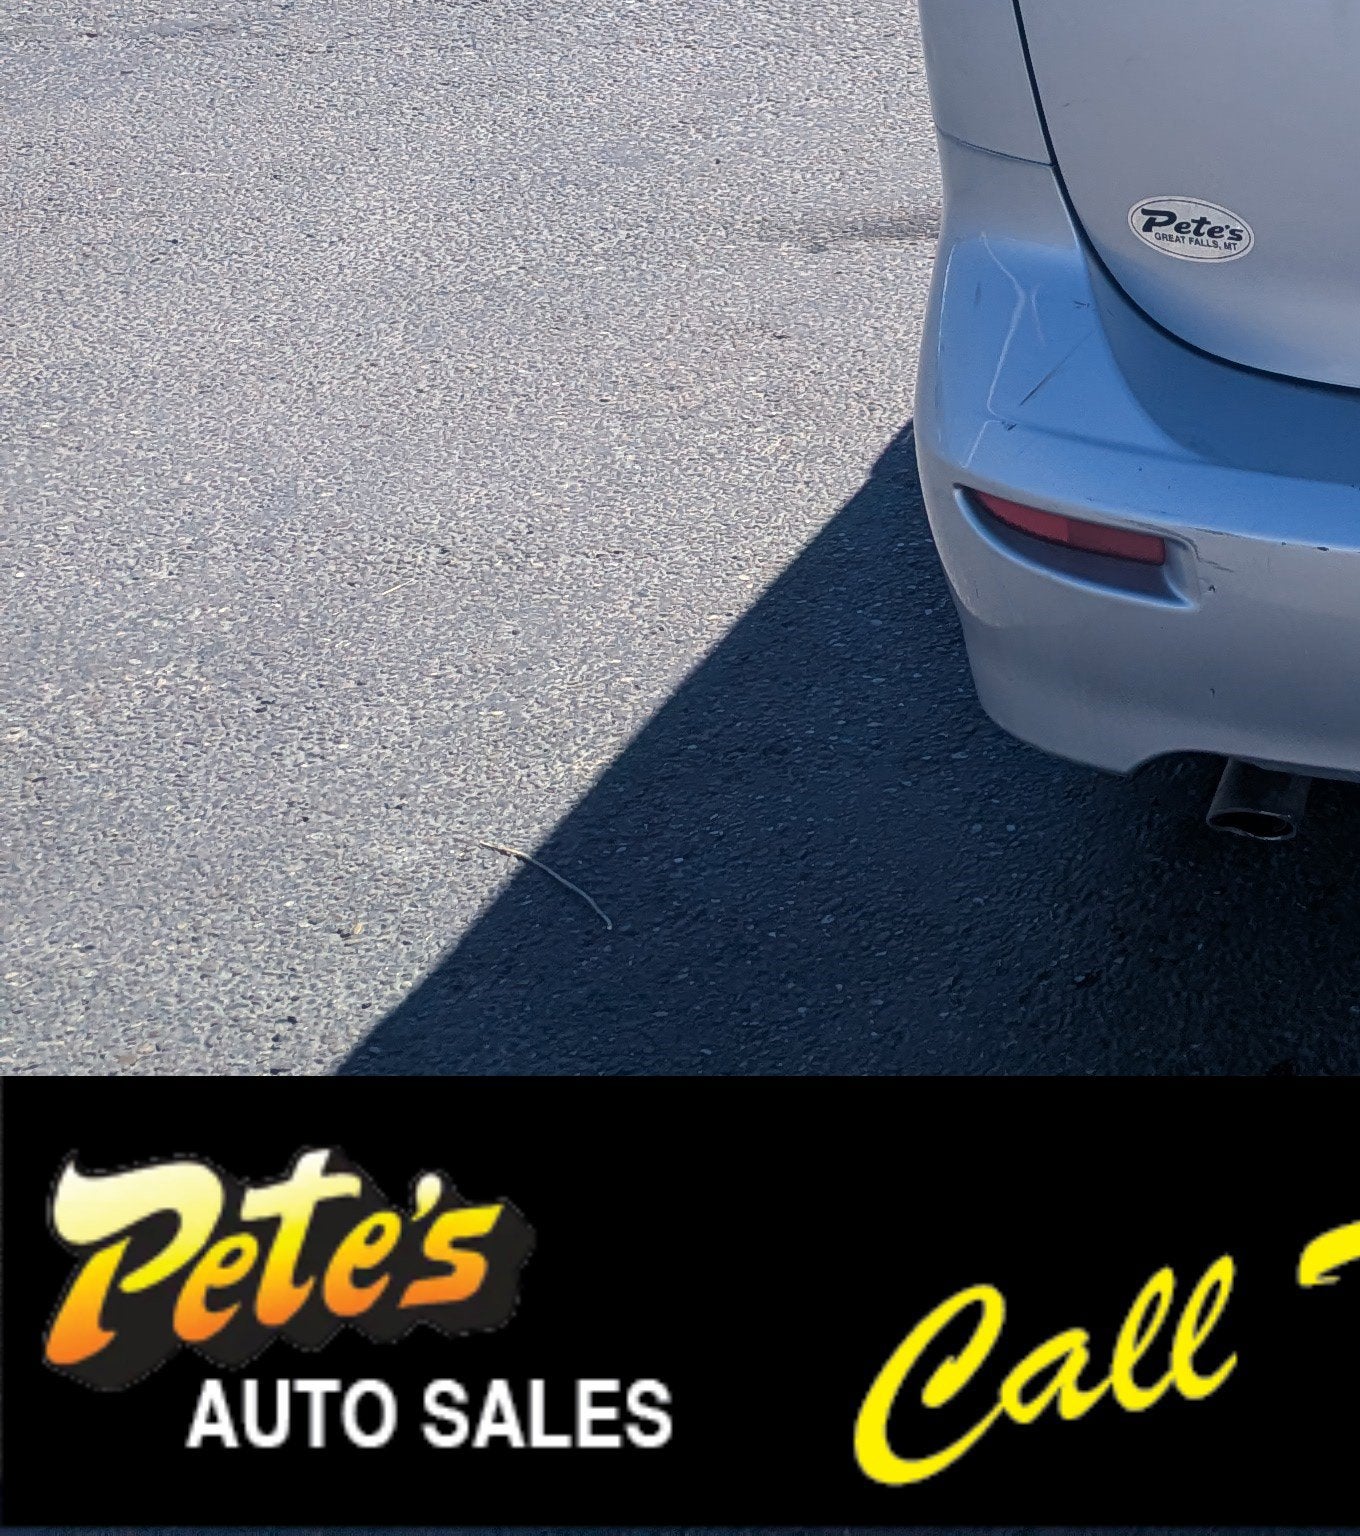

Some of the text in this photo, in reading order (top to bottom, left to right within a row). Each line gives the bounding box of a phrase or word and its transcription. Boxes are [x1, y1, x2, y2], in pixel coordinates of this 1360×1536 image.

[1141, 208, 1244, 241] Pete's
[1154, 231, 1185, 244] GREAT
[1223, 241, 1237, 251] MT
